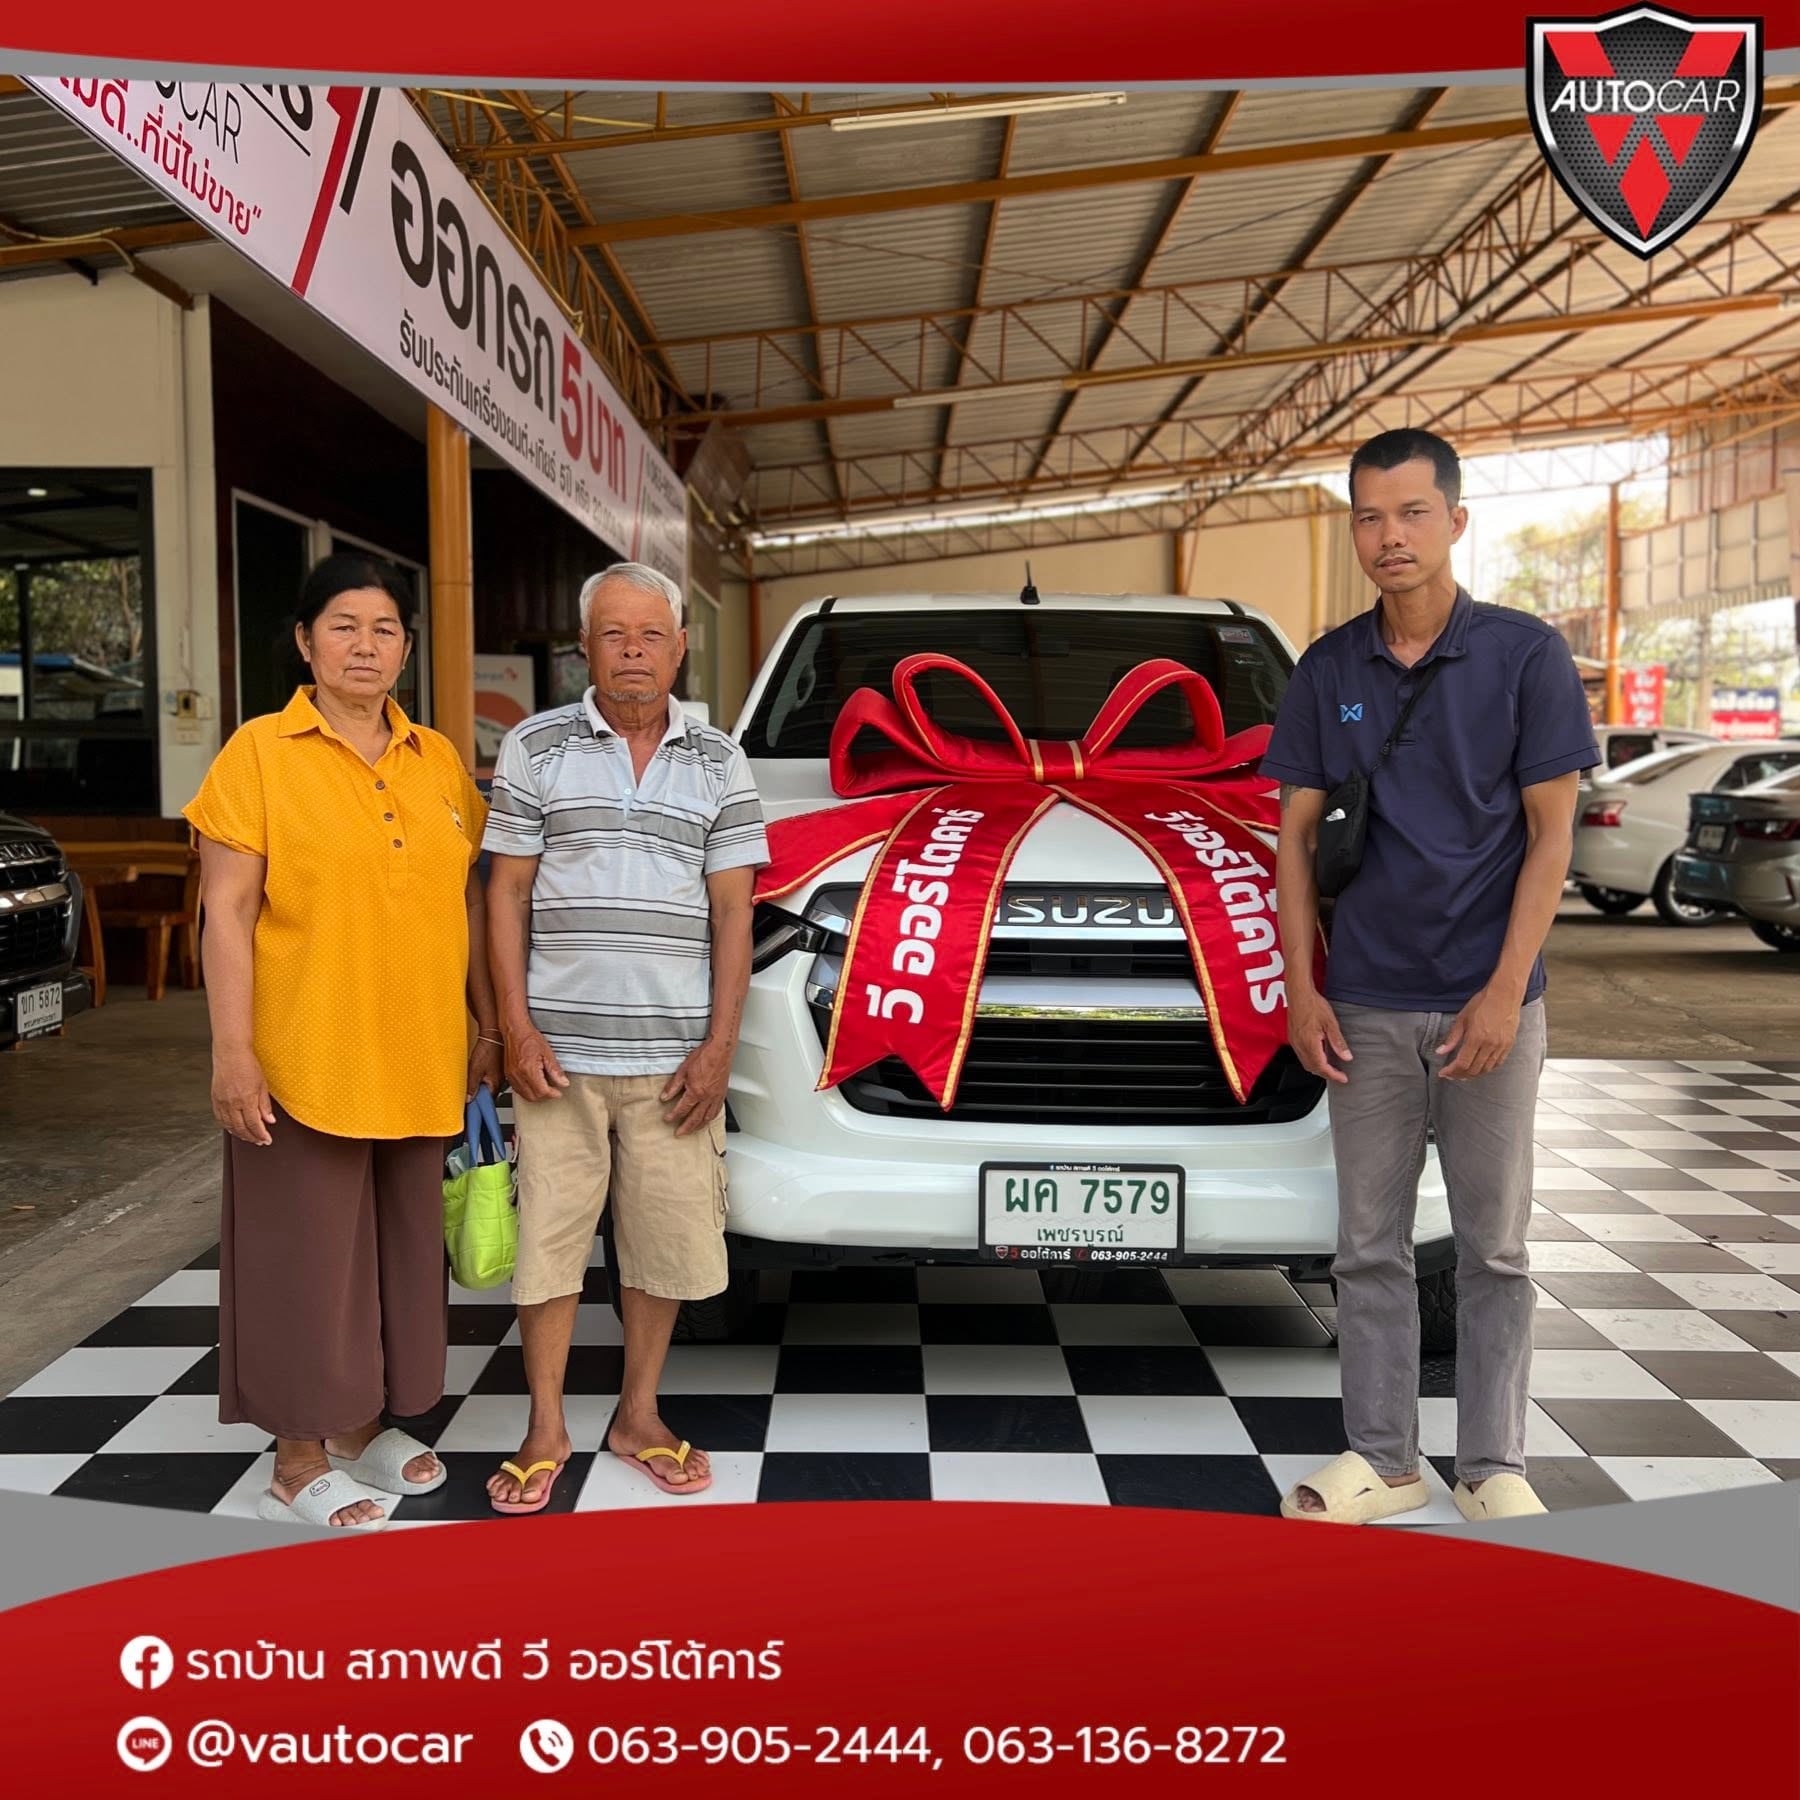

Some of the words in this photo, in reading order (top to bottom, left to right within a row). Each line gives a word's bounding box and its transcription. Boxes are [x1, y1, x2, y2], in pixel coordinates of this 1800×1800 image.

[39, 986, 61, 1010] 5872
[865, 984, 924, 1024] วี
[1005, 1177, 1058, 1213] ผค
[1080, 1178, 1170, 1215] 7579
[1037, 1224, 1124, 1248] เพชรบูรณ์
